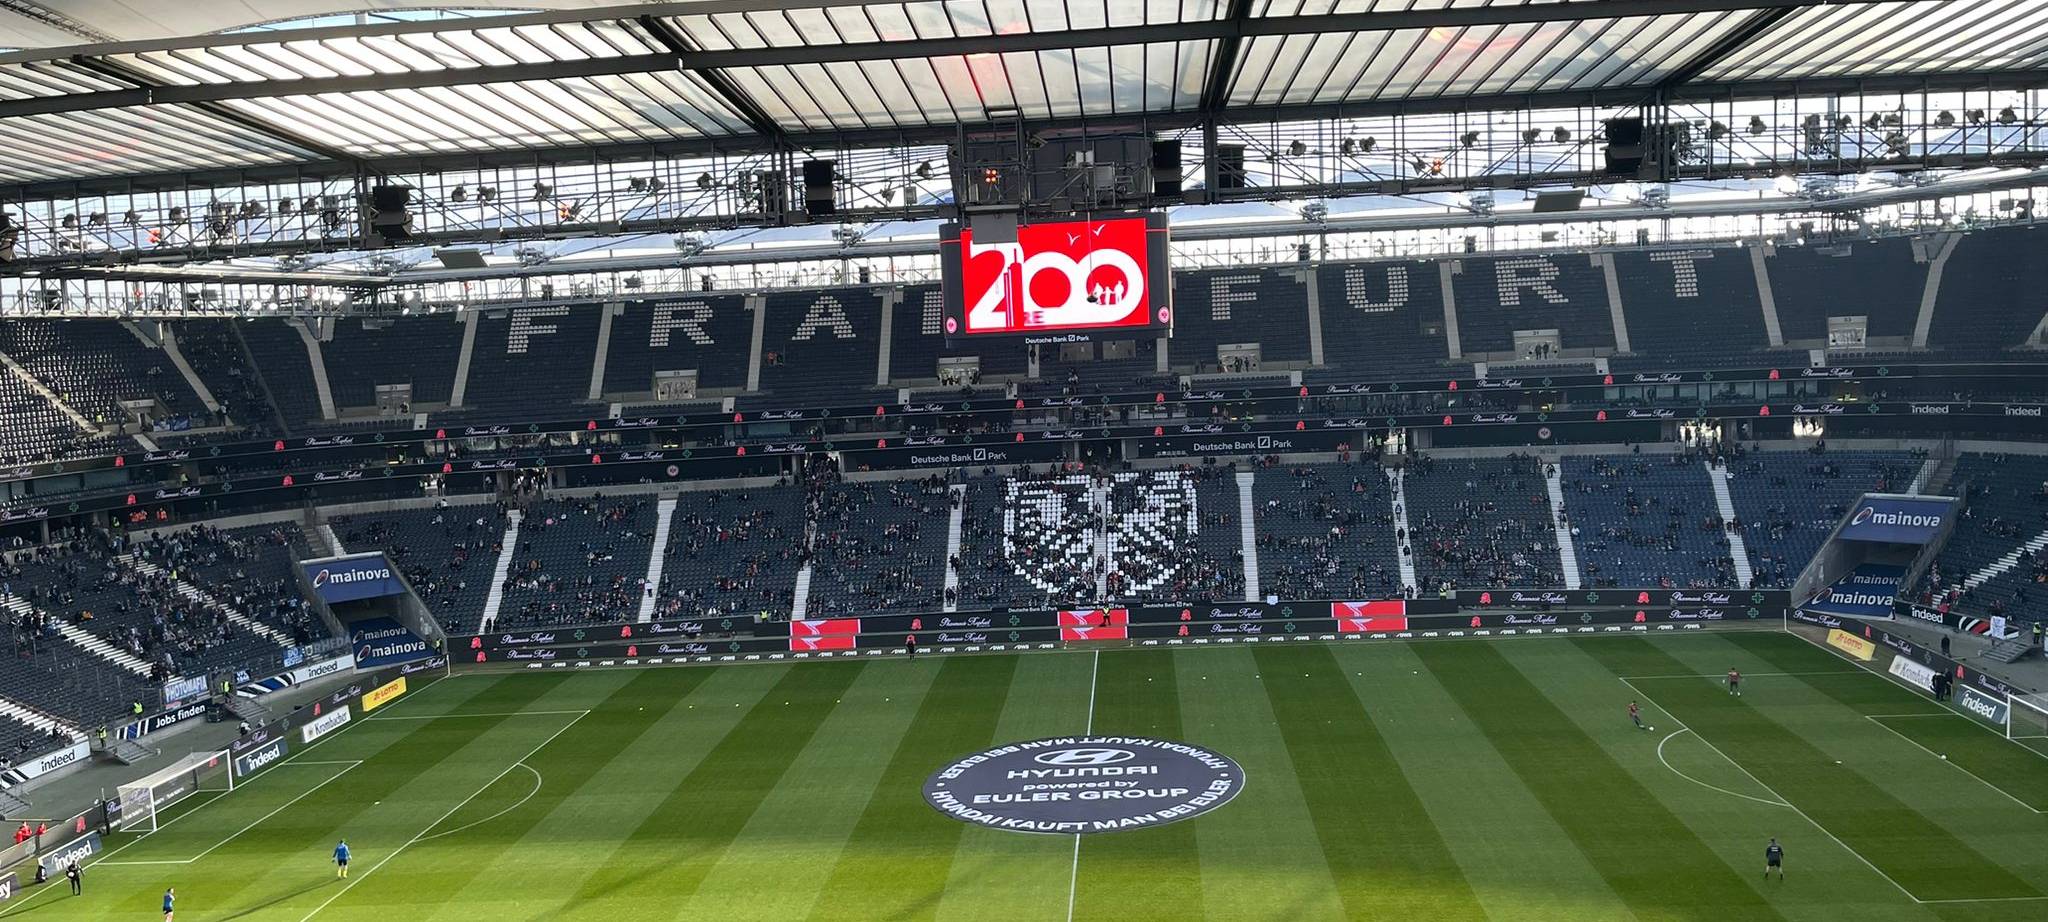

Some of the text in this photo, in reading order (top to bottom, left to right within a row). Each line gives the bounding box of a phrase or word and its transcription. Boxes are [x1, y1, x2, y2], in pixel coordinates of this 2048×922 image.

[969, 241, 1144, 329] 200
[507, 251, 1714, 354] F R A F U R T
[1912, 405, 1949, 414] indeed
[2005, 406, 2041, 416] indeed
[1194, 440, 1292, 451] Deutsche Bank Park
[911, 452, 1006, 464] Deutsche Bank Park
[1873, 510, 1940, 526] mainova
[331, 567, 390, 583] mainova
[1831, 592, 1894, 606] mainova
[1912, 606, 1943, 624] indeed
[364, 626, 407, 640] mainova
[372, 640, 426, 657] mainova
[308, 661, 338, 677] indeed
[1962, 691, 1996, 719] indeed
[156, 703, 205, 729] Jobs finden
[315, 712, 348, 736] Krombacher
[41, 750, 75, 772] indeed
[247, 744, 280, 771] indeed
[1008, 766, 1158, 779] HYUNDAI
[1024, 779, 1138, 791] powered by
[973, 788, 1189, 804] EULER GROUP
[932, 780, 1233, 830] HYUNDAI KAUFT MAN BEI EULER
[53, 840, 92, 871] indeed
